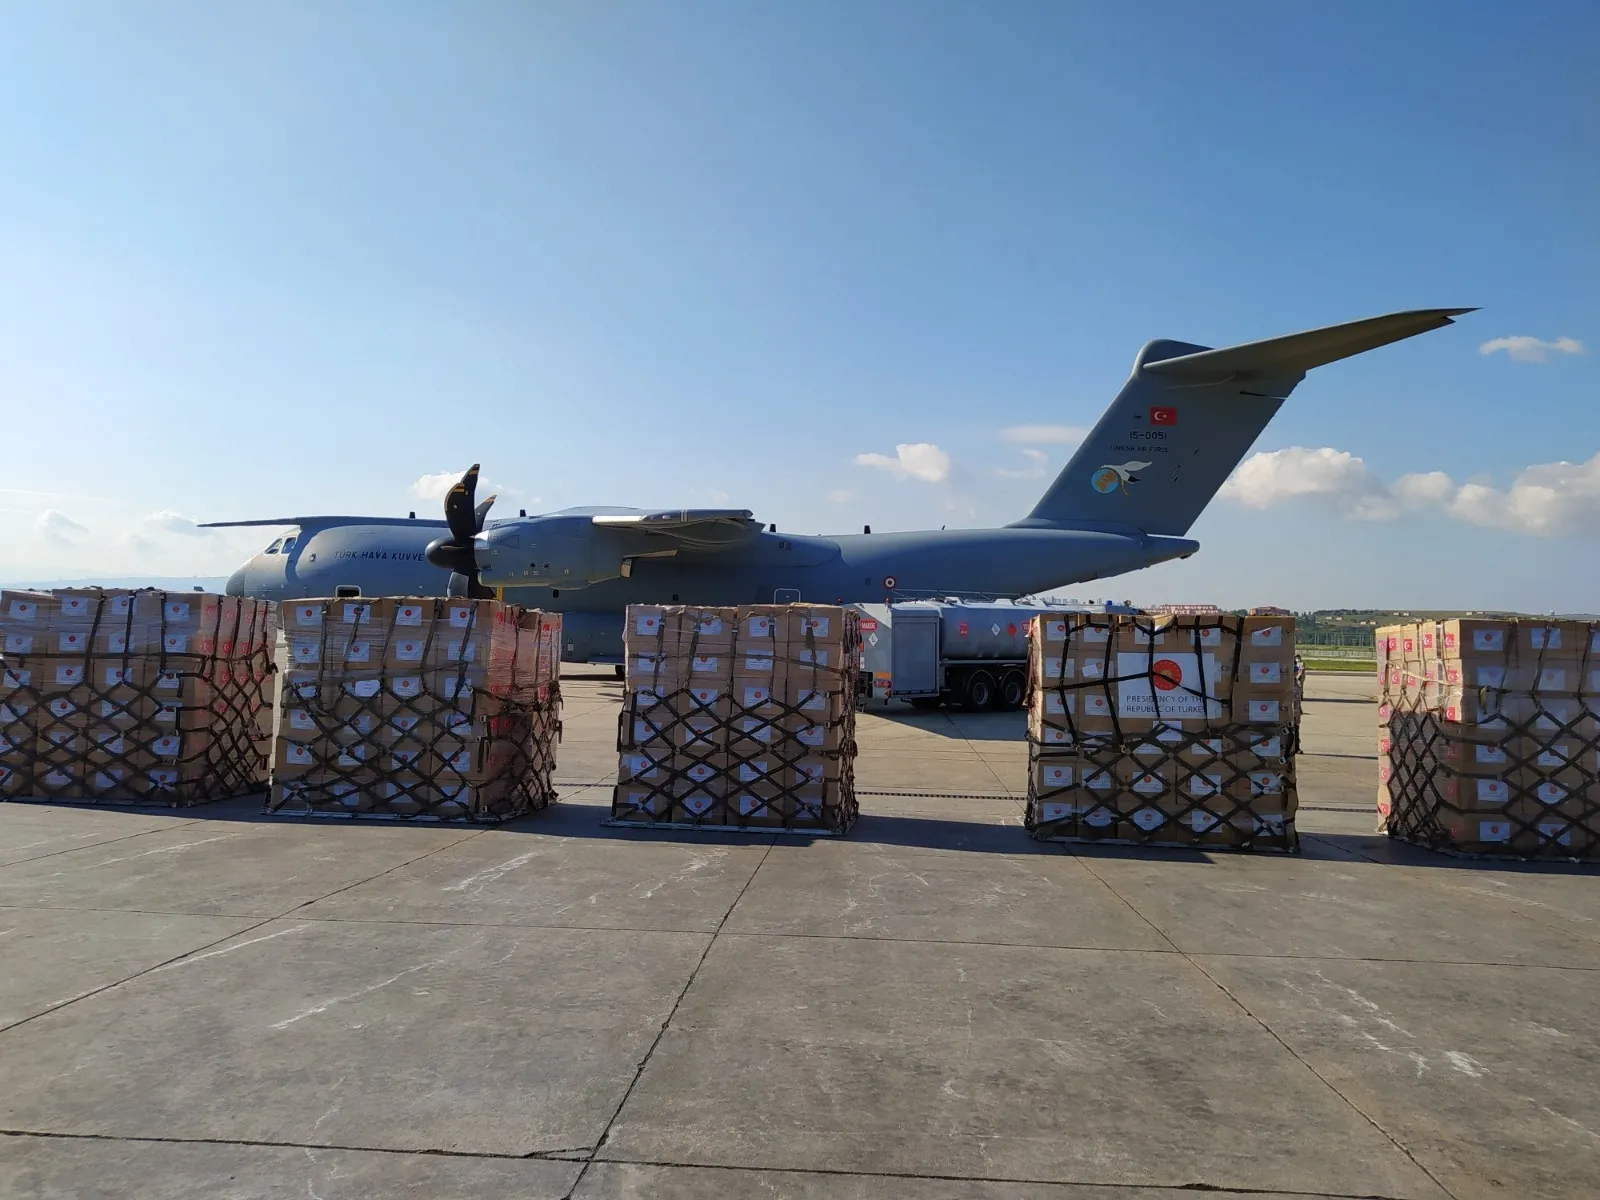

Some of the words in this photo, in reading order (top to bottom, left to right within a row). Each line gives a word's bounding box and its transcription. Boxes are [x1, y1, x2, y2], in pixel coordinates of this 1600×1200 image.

[1129, 431, 1167, 440] 15-0051
[361, 551, 388, 560] HAVA
[1126, 695, 1175, 703] PRESIDNCY
[1178, 695, 1188, 703] OF
[1191, 695, 1205, 703] TH
[1126, 705, 1163, 713] REPUBLC
[1165, 705, 1175, 713] OF
[1178, 705, 1206, 713] TURKE
